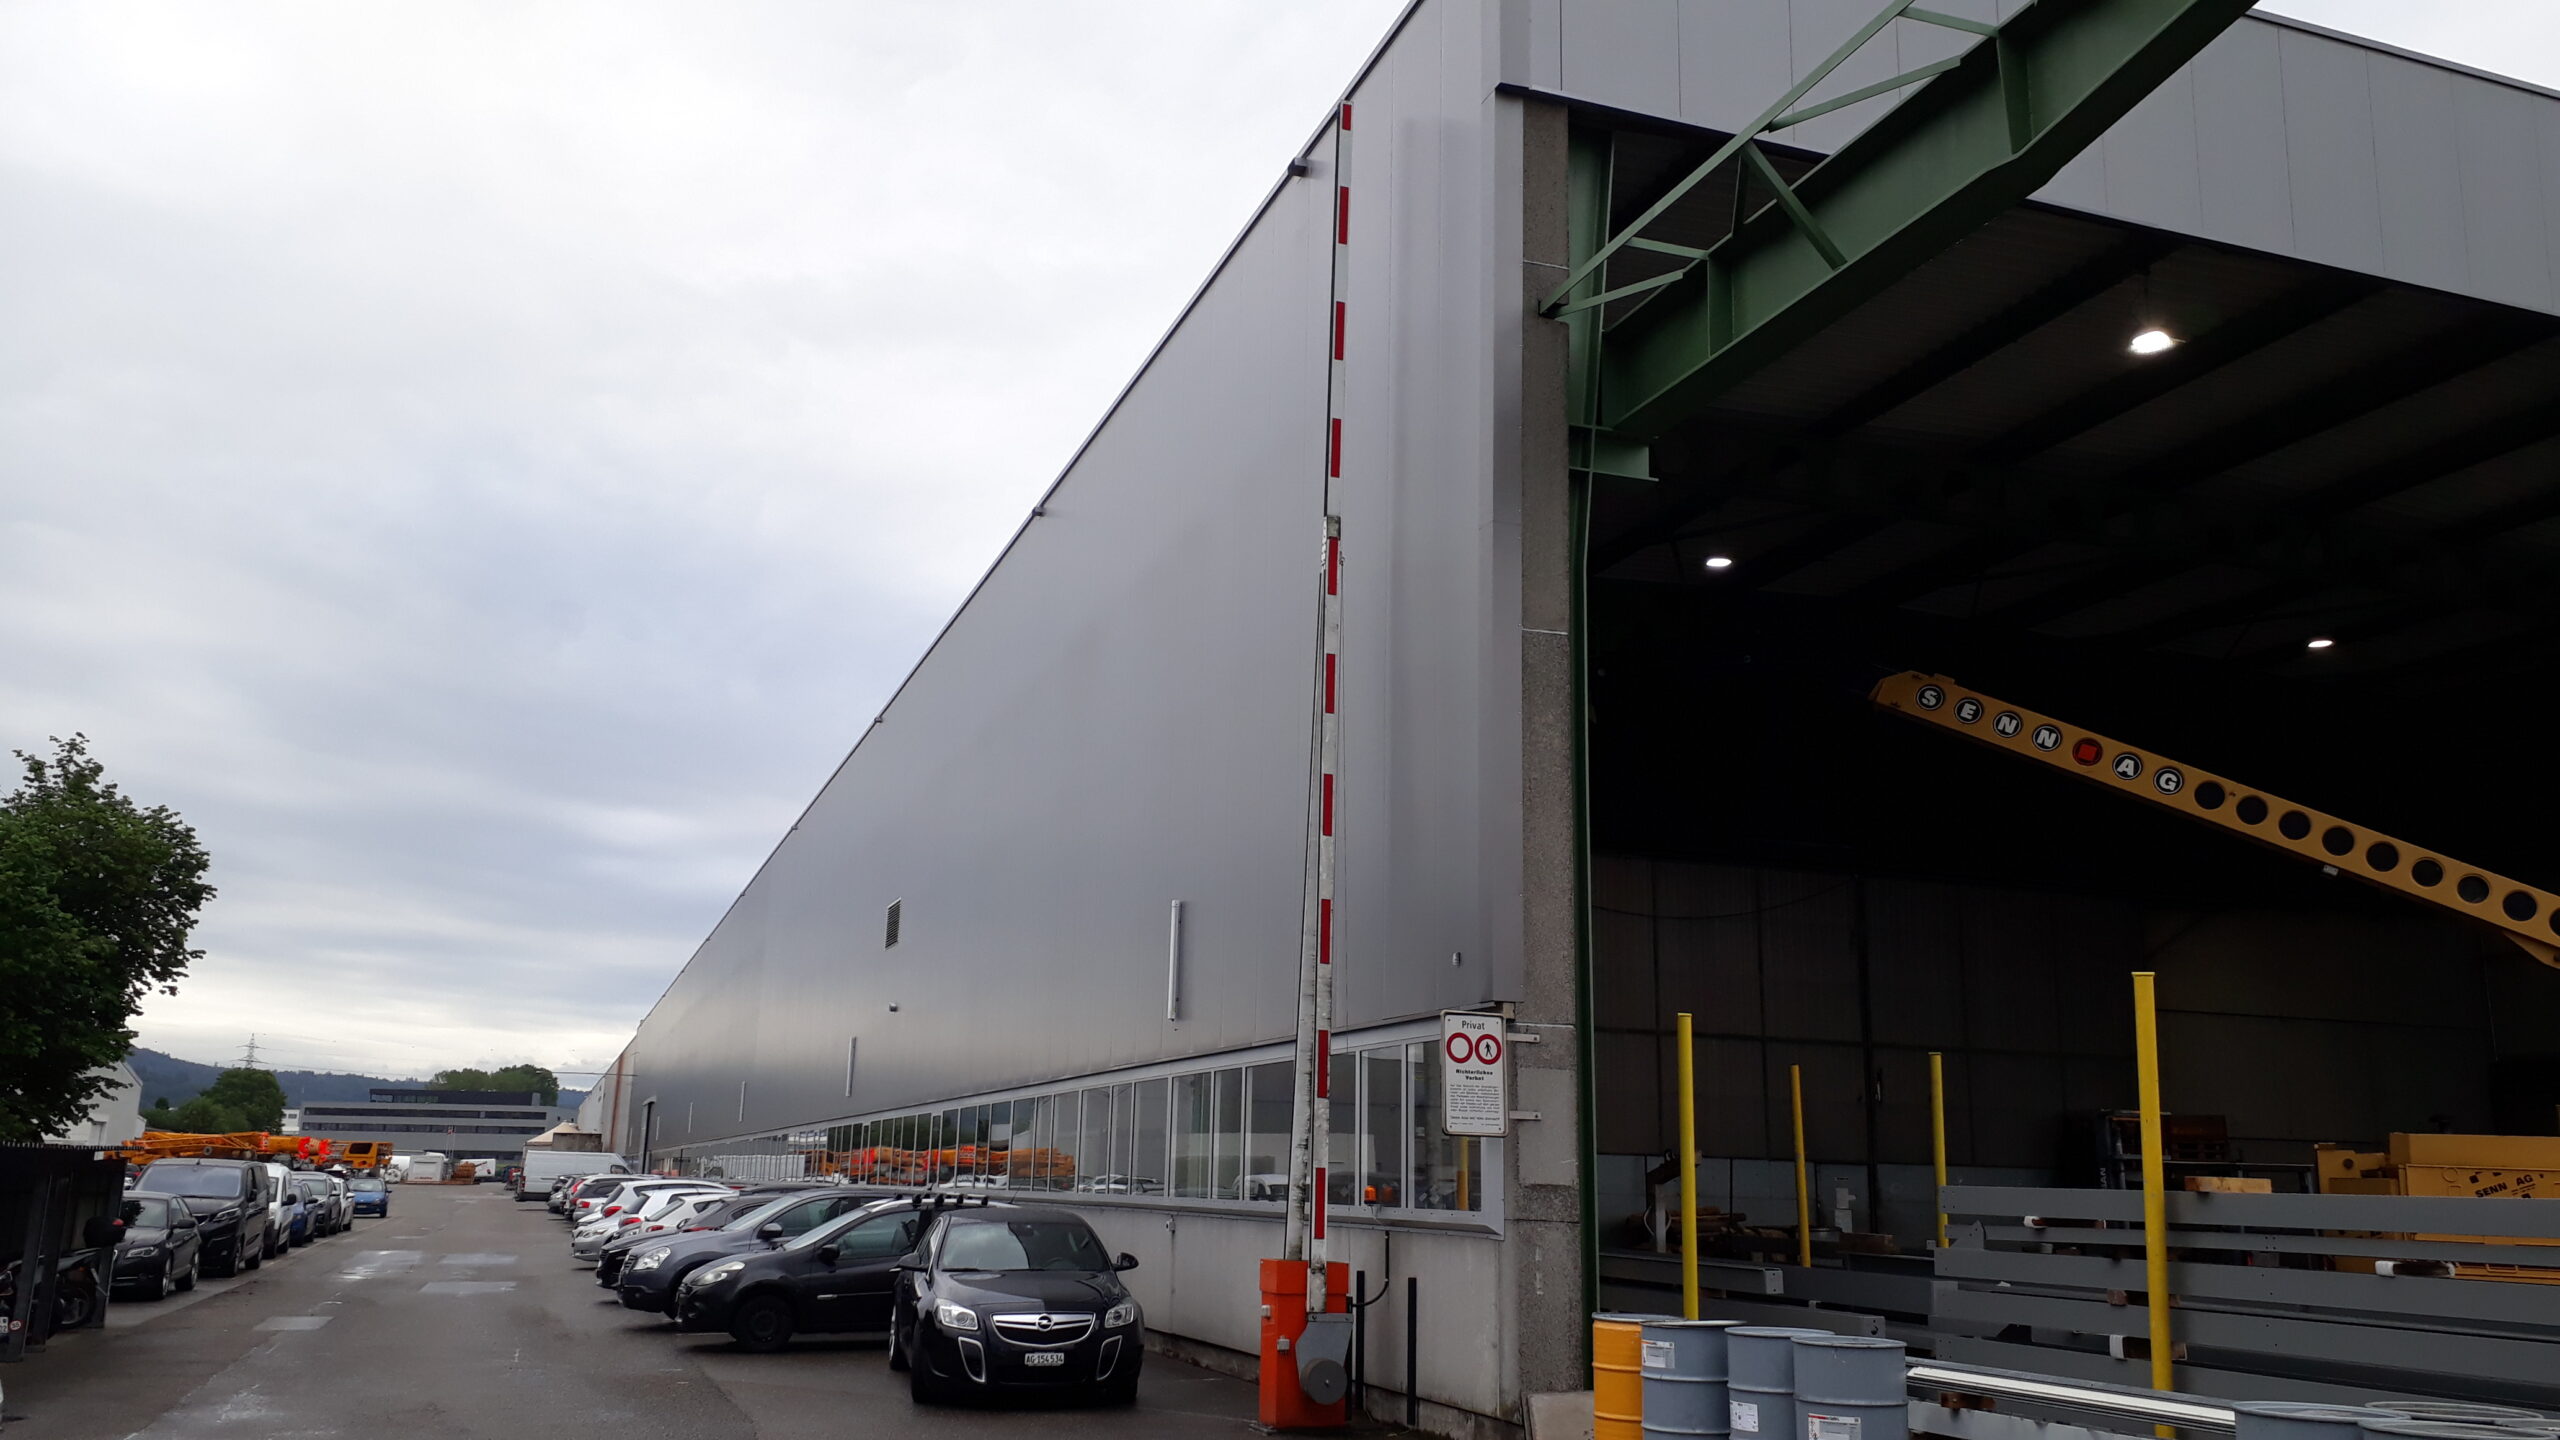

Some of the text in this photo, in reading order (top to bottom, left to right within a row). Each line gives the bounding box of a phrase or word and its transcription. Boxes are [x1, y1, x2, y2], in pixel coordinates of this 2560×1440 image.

[1919, 688, 2180, 792] SENN AG
[1461, 1020, 1485, 1030] Privat
[2475, 1182, 2508, 1198] SENN
[2516, 1174, 2534, 1186] AG
